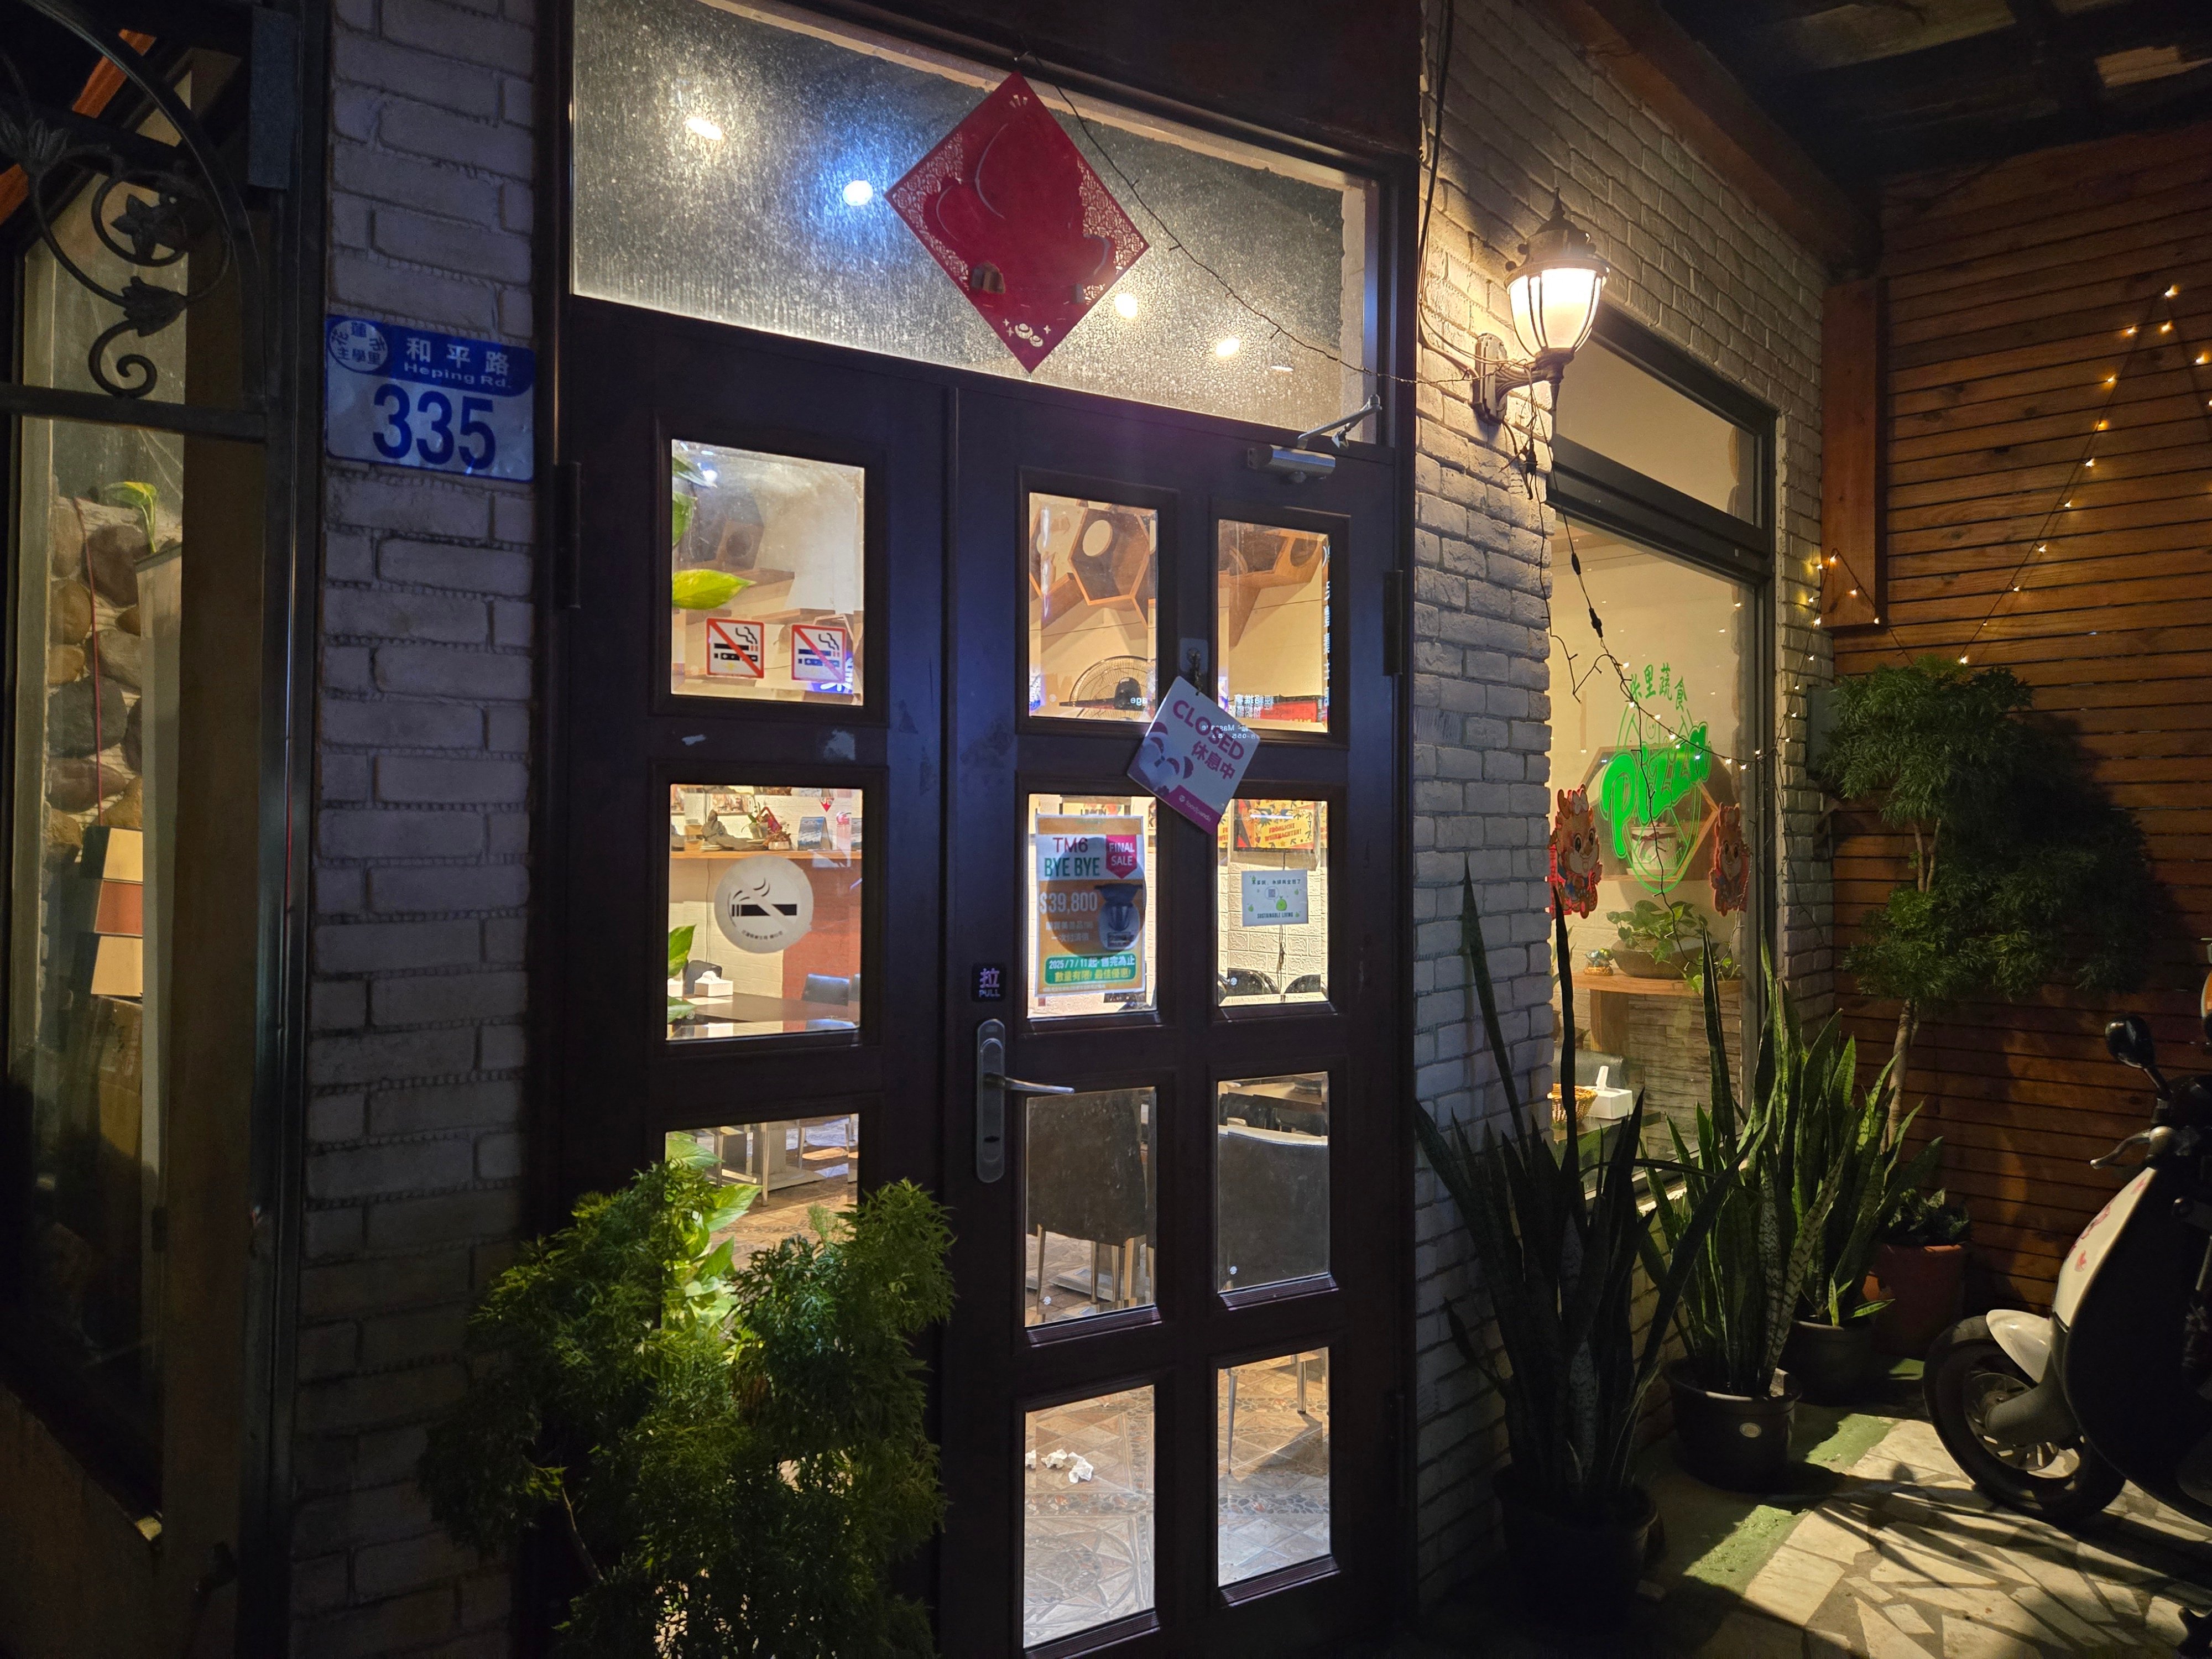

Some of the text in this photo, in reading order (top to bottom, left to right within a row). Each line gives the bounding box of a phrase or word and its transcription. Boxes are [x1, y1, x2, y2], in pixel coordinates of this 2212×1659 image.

[406, 337, 509, 376] 和平路
[404, 362, 512, 388] Heping Rd.
[372, 383, 495, 469] 335
[1172, 700, 1244, 760] CLOSED
[1191, 740, 1236, 780] 休息中
[1052, 837, 1088, 853] TM6
[1109, 842, 1135, 853] FINAL
[1044, 857, 1100, 877] BYE BYE
[1111, 855, 1133, 866] SALE
[1039, 891, 1098, 915] $39,800
[979, 968, 1000, 988] 拉
[979, 989, 1000, 998] PULL
